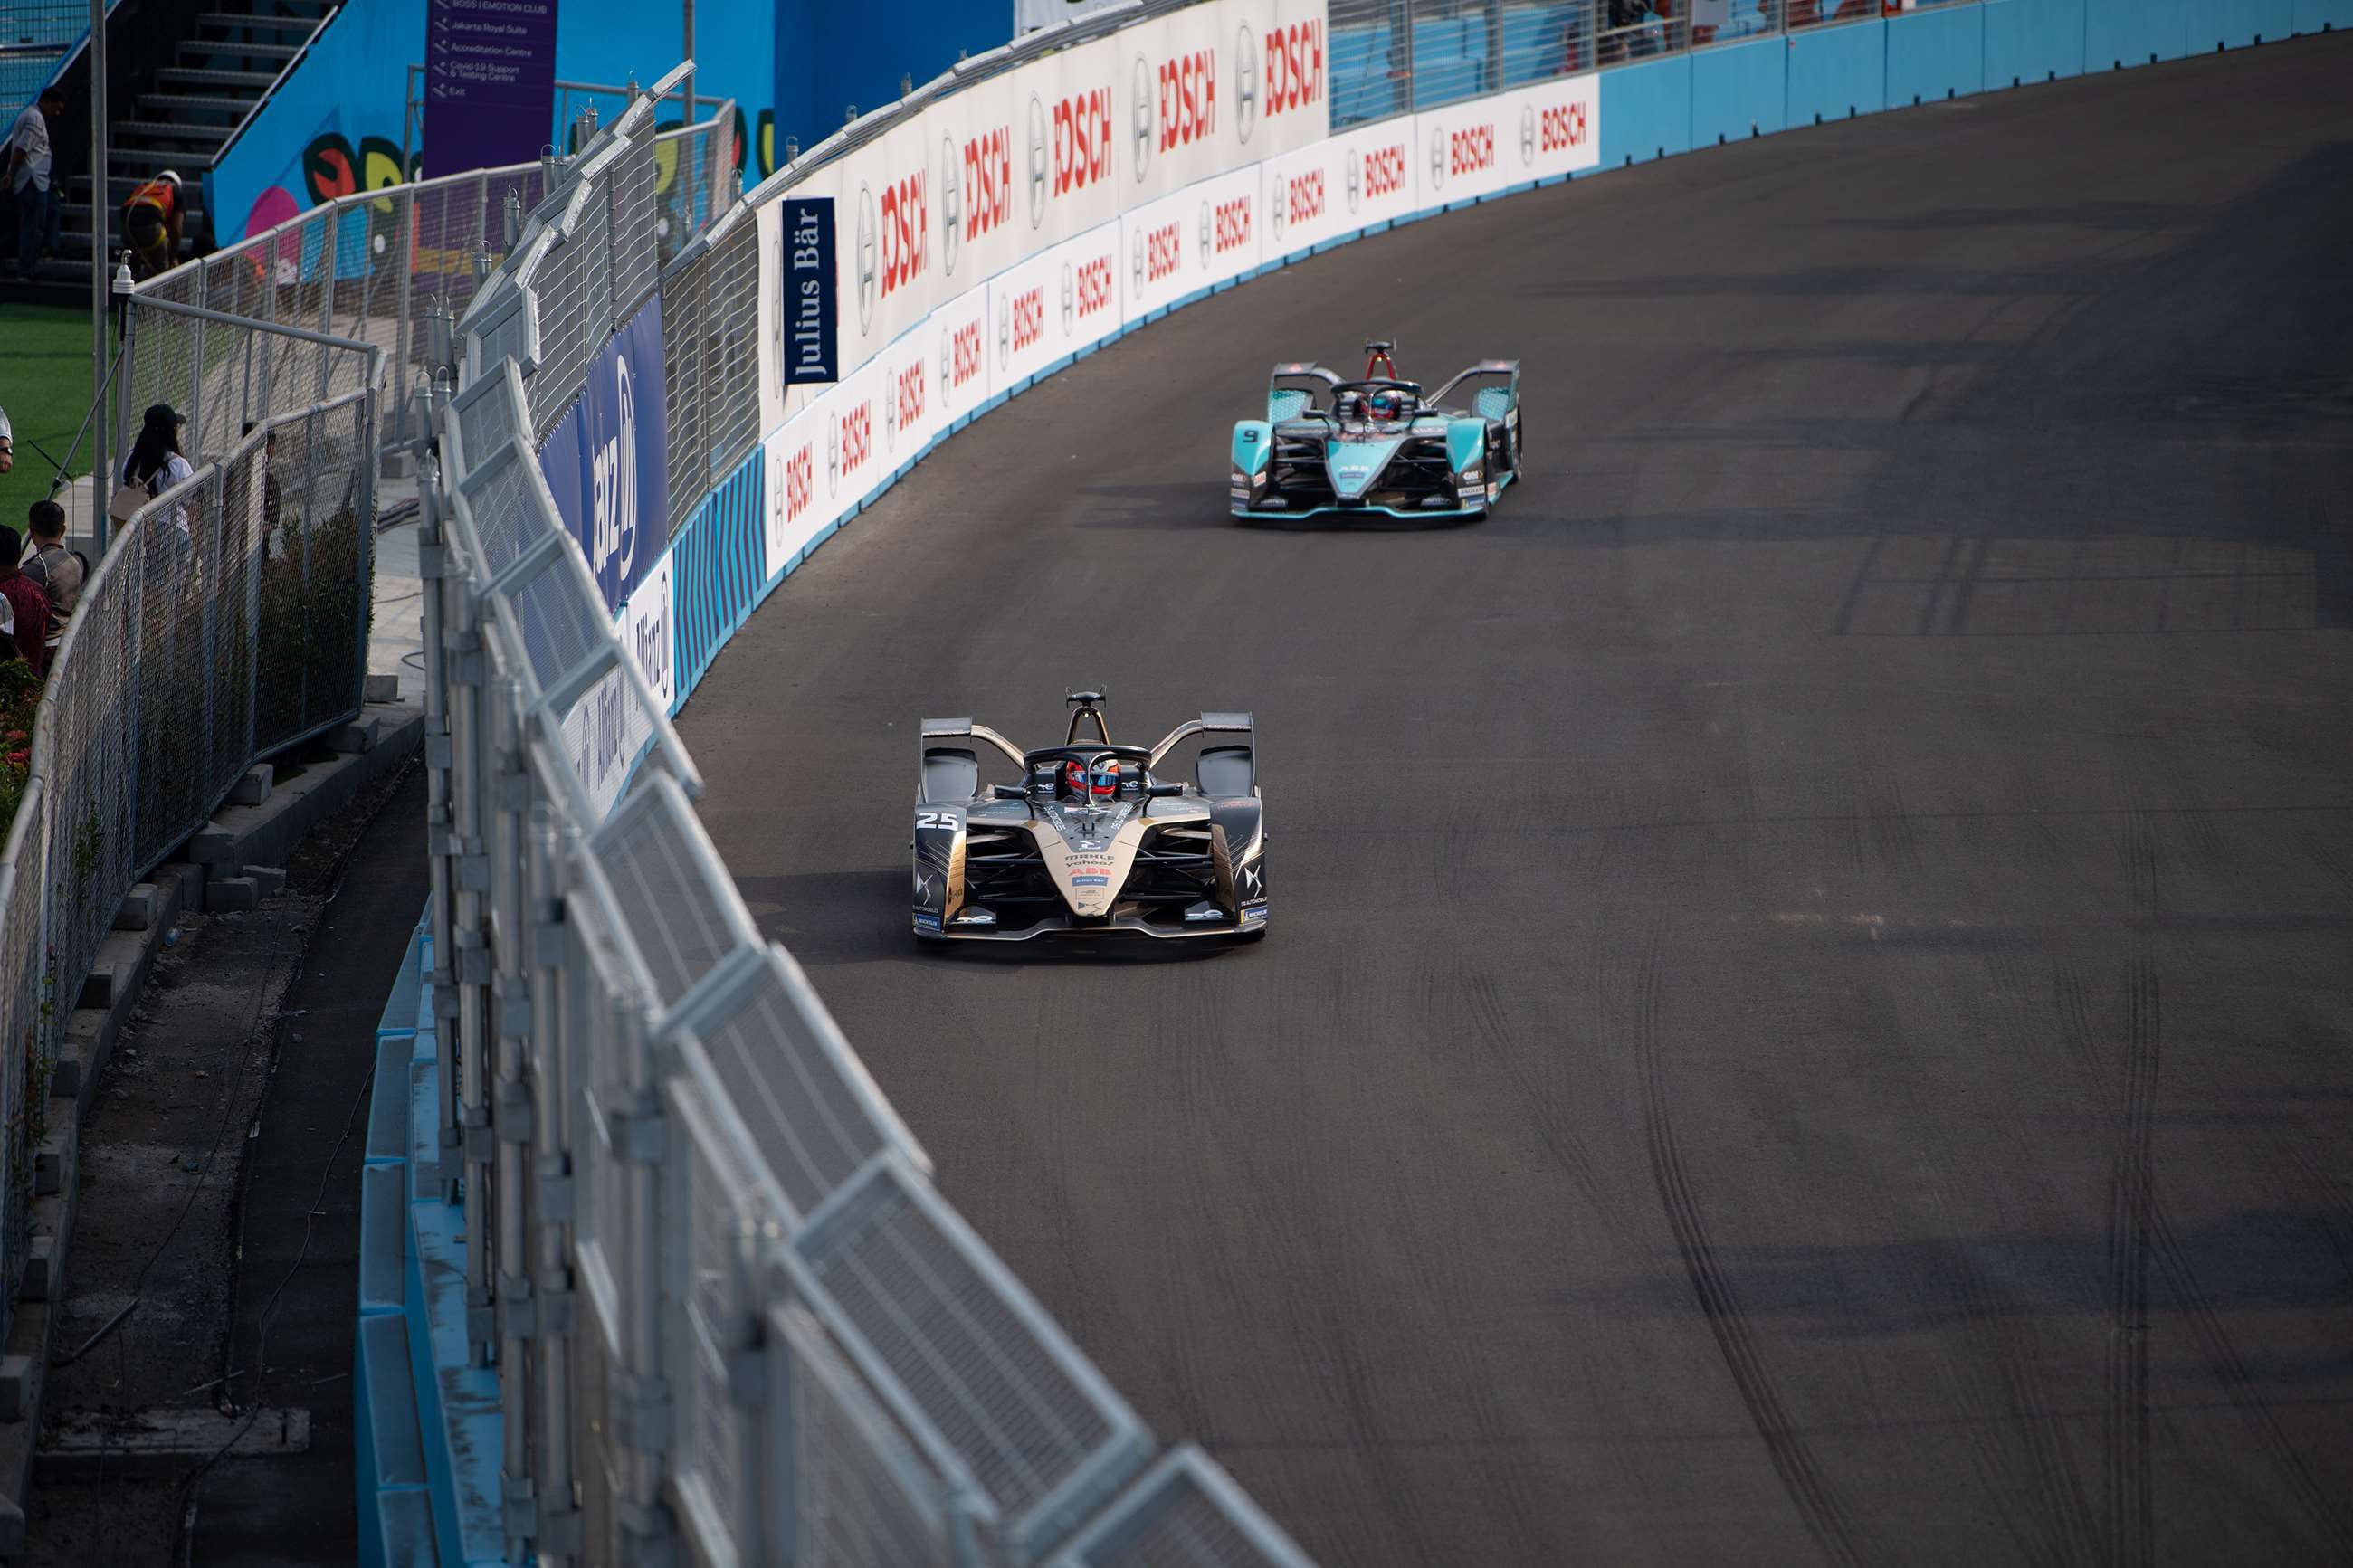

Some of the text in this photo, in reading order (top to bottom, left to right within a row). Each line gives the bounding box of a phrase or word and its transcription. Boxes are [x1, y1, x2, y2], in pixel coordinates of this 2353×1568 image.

[452, 22, 527, 34] Jakarta Royal Suite
[482, 1, 522, 12] EMOTION
[523, 5, 547, 14] CLUB
[452, 43, 532, 57] Accreditation Centre
[1264, 18, 1323, 117] BOSCH
[1159, 49, 1216, 155] BOSCH
[1541, 101, 1586, 153] BOSCH
[1053, 87, 1112, 199] BOSCH
[1365, 143, 1405, 199] BOSCH
[1451, 124, 1494, 175] BOSCH
[1216, 195, 1251, 252] BOSCH
[1289, 168, 1325, 225] BOSCH
[1148, 221, 1180, 282] BOSCH
[794, 208, 827, 375] Julius Bär
[1077, 253, 1112, 319] BOSCH
[1013, 285, 1043, 353] BOSCH
[953, 318, 982, 390] BOSCH
[898, 358, 925, 432] BOSCH
[841, 399, 871, 478] BOSCH
[1243, 430, 1258, 443] 9
[786, 441, 813, 524] BOSCH
[916, 813, 959, 831] 25
[1068, 866, 1112, 875] ABB
